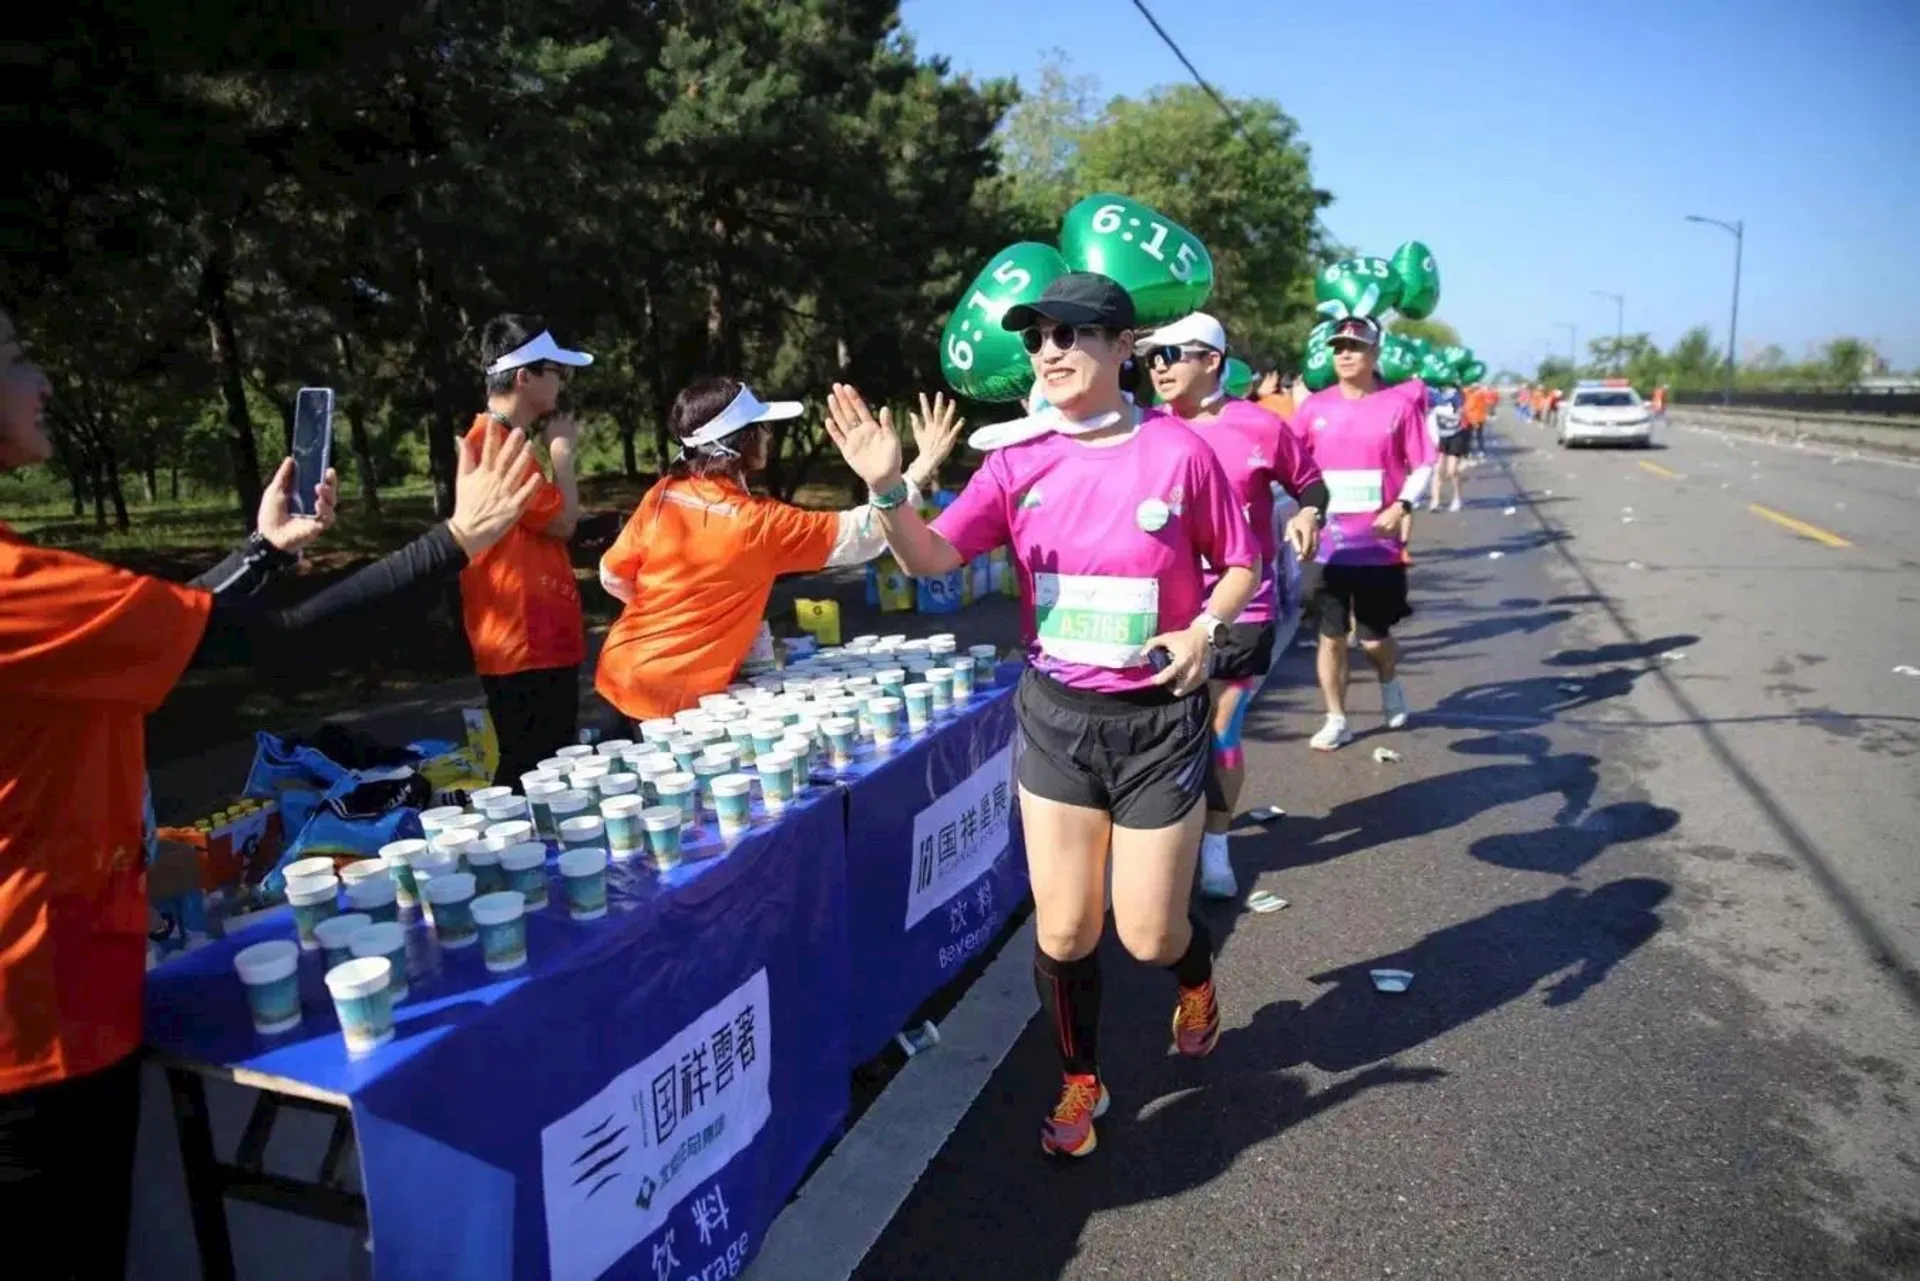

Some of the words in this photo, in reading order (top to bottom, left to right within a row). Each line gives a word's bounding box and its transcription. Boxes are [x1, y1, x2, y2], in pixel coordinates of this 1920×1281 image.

[1091, 203, 1200, 283] 6:15
[1324, 257, 1390, 284] 6:15
[947, 259, 1032, 371] 6:15
